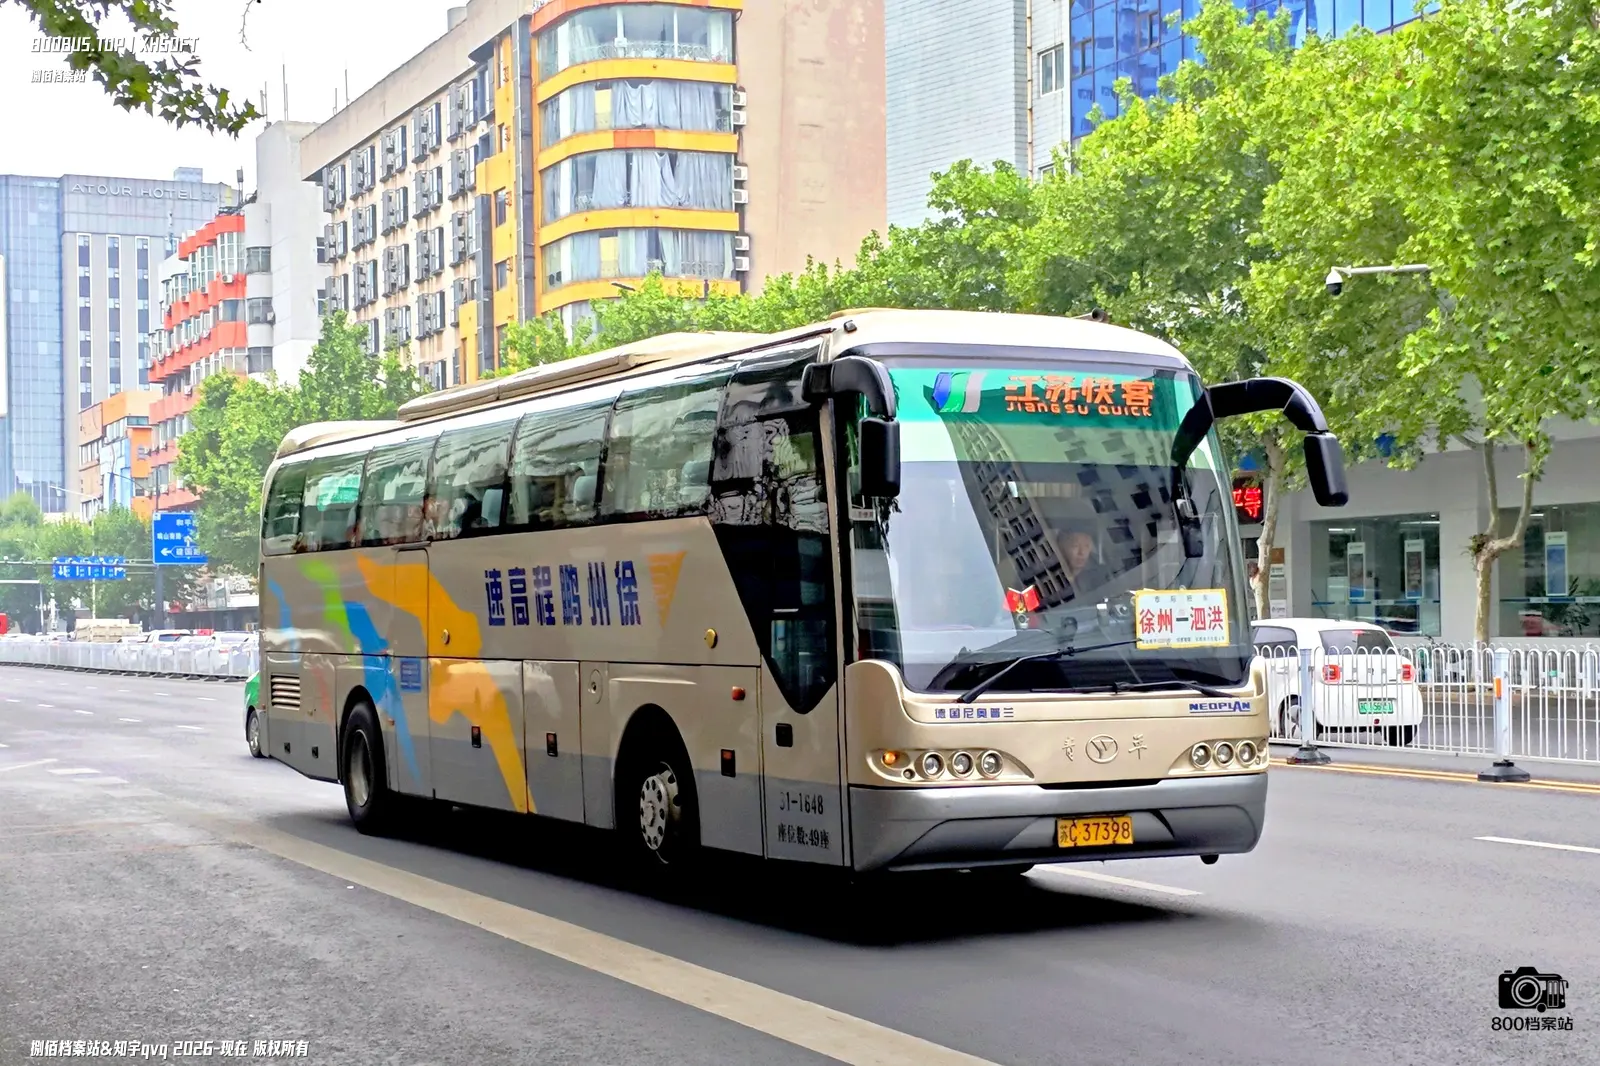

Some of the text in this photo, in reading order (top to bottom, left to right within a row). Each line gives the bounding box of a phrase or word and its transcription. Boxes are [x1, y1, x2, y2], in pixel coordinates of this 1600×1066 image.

[71, 183, 132, 196] ATOUR
[140, 187, 199, 200] HOTEL
[1004, 375, 1155, 406] 江苏快客
[934, 707, 1014, 719] 德国尼奥普兰
[1189, 702, 1250, 713] NEOPLAN
